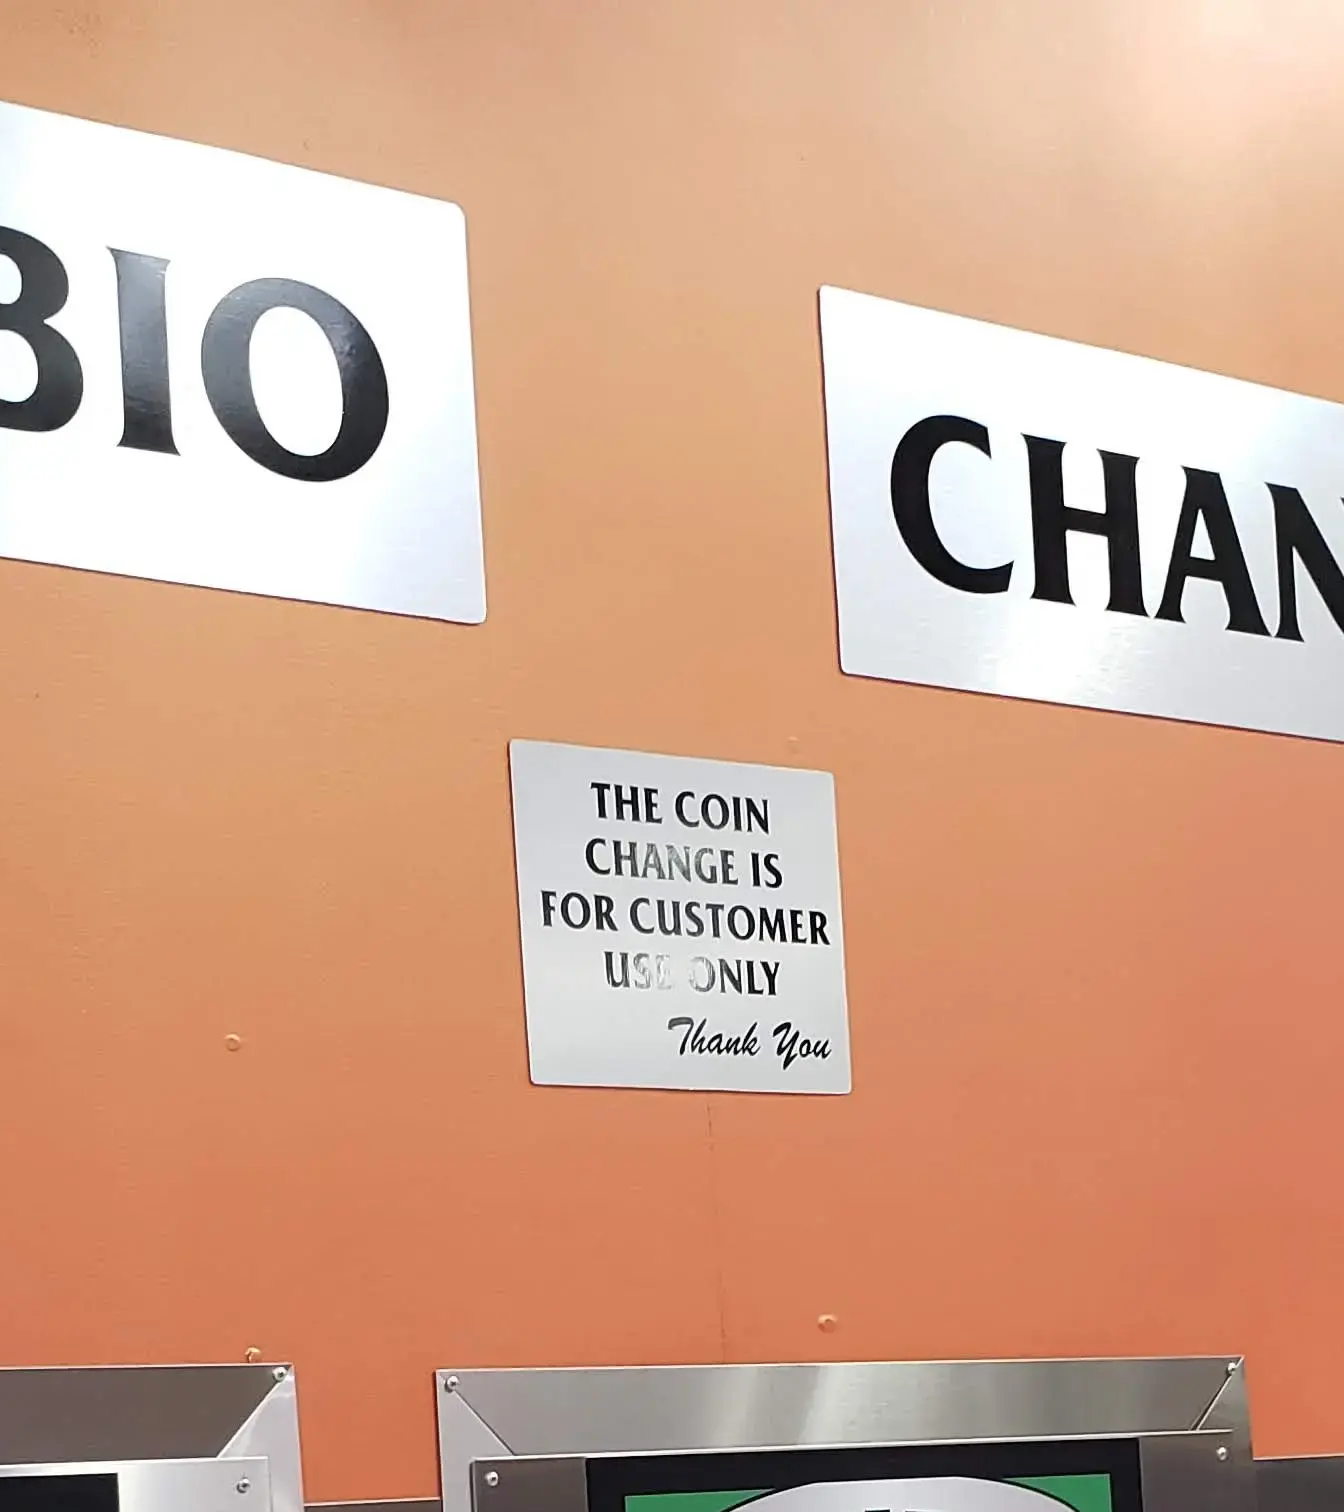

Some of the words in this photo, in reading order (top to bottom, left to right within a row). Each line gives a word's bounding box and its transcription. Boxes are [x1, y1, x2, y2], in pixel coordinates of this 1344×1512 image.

[590, 782, 663, 824] THE
[674, 790, 770, 835] COIN
[584, 837, 739, 886] CHANGE
[750, 851, 784, 889] IS
[540, 889, 619, 932] FOR
[628, 897, 831, 946] CUSTOMER
[604, 951, 673, 990] USE
[688, 955, 781, 996] ONLY
[667, 1016, 761, 1056] Thank
[772, 1021, 833, 1071] You
